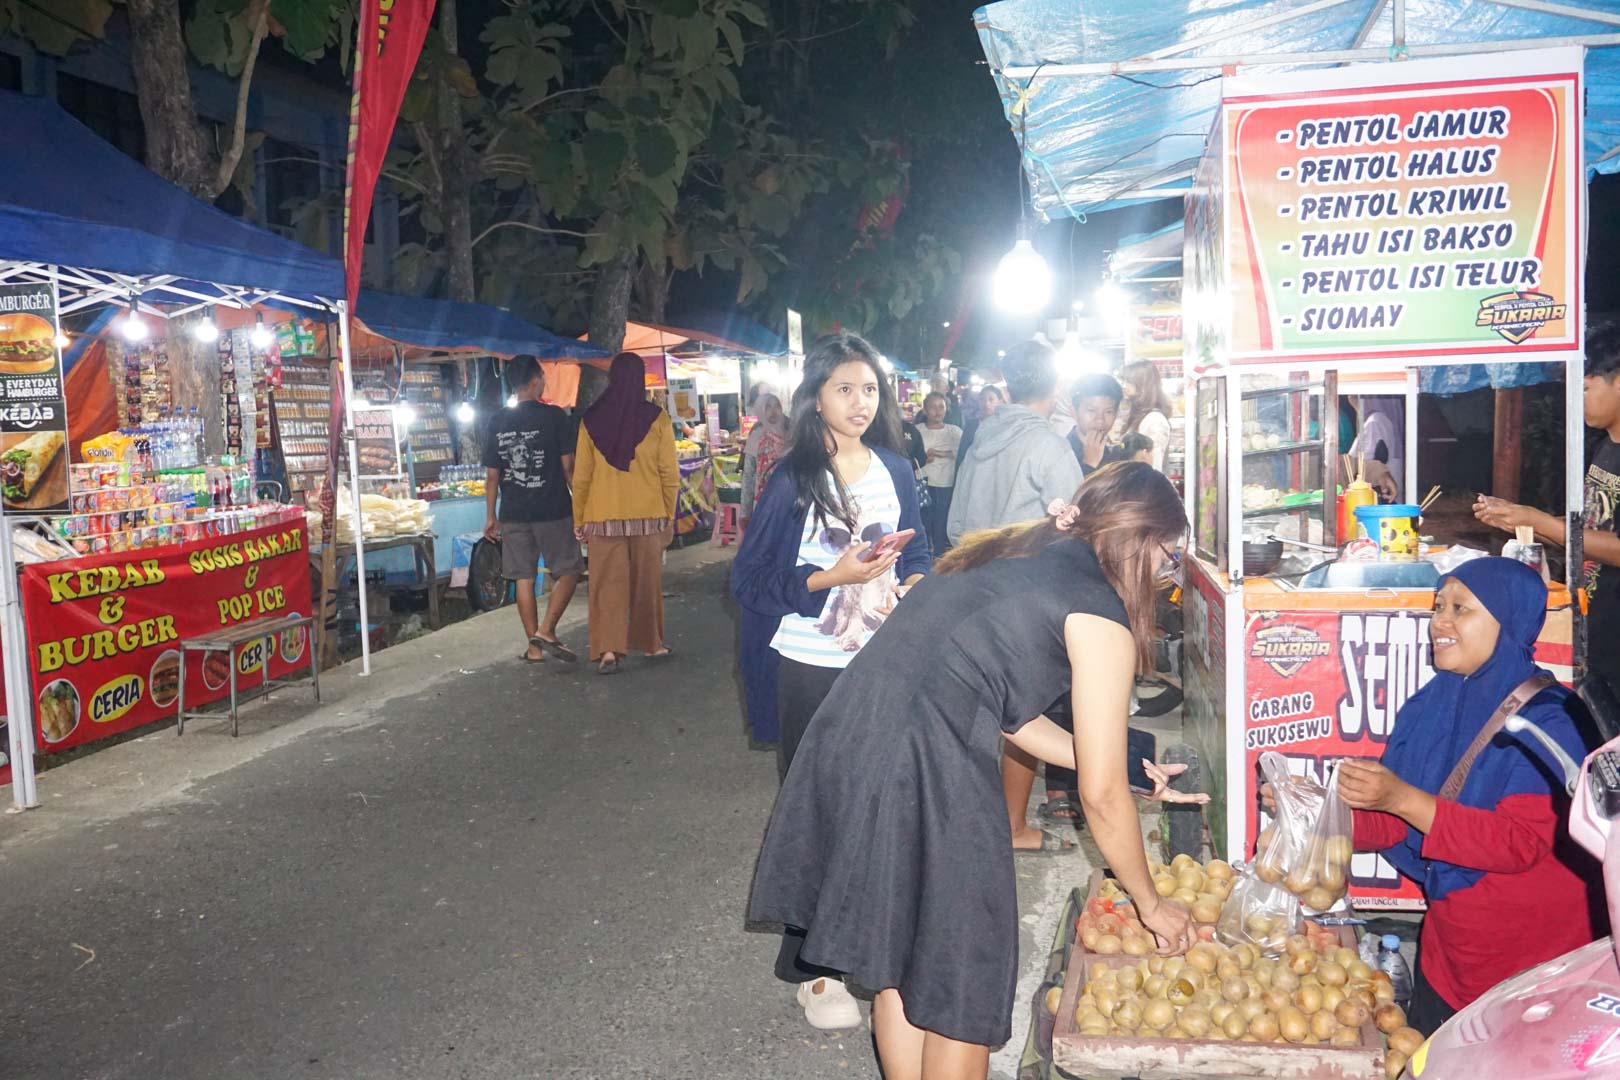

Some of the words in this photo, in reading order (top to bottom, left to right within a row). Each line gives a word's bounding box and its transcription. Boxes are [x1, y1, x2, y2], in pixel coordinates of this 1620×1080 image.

[1300, 118, 1398, 146] PENTOL
[1407, 110, 1507, 139] JAMUR
[1301, 156, 1398, 183] PENTOL
[1407, 149, 1496, 176] HALUS
[1301, 193, 1398, 220] PENTOL
[1408, 187, 1507, 215] KRIWIL
[1301, 232, 1369, 257] TAHU
[1378, 229, 1412, 252] ISI
[1424, 224, 1512, 251] BAKSO
[1302, 268, 1399, 294] PENTOL
[1409, 265, 1444, 289] ISI
[1456, 260, 1538, 286] TELUR
[1301, 304, 1403, 331] SIOMAY
[1475, 305, 1566, 326] SUKARIA
[6, 378, 57, 389] EVERYDAY
[7, 387, 58, 398] HAMBURGER
[0, 407, 54, 421] KEBAB
[356, 411, 392, 425] SOSIS
[356, 425, 393, 439] BAKAR
[188, 547, 244, 575] SOSIS
[244, 528, 302, 562] BAKAR
[48, 559, 165, 603] KEBAB
[244, 565, 259, 588] &
[98, 595, 126, 624] &
[217, 593, 252, 624] POP
[257, 585, 286, 613] ICE
[38, 615, 178, 673] BURGER
[240, 635, 274, 671] CERA
[1251, 640, 1331, 657] SUKARIA
[93, 679, 140, 721] CERIA
[1251, 693, 1312, 719] CABANG
[1248, 718, 1331, 748] SUKOSEWU
